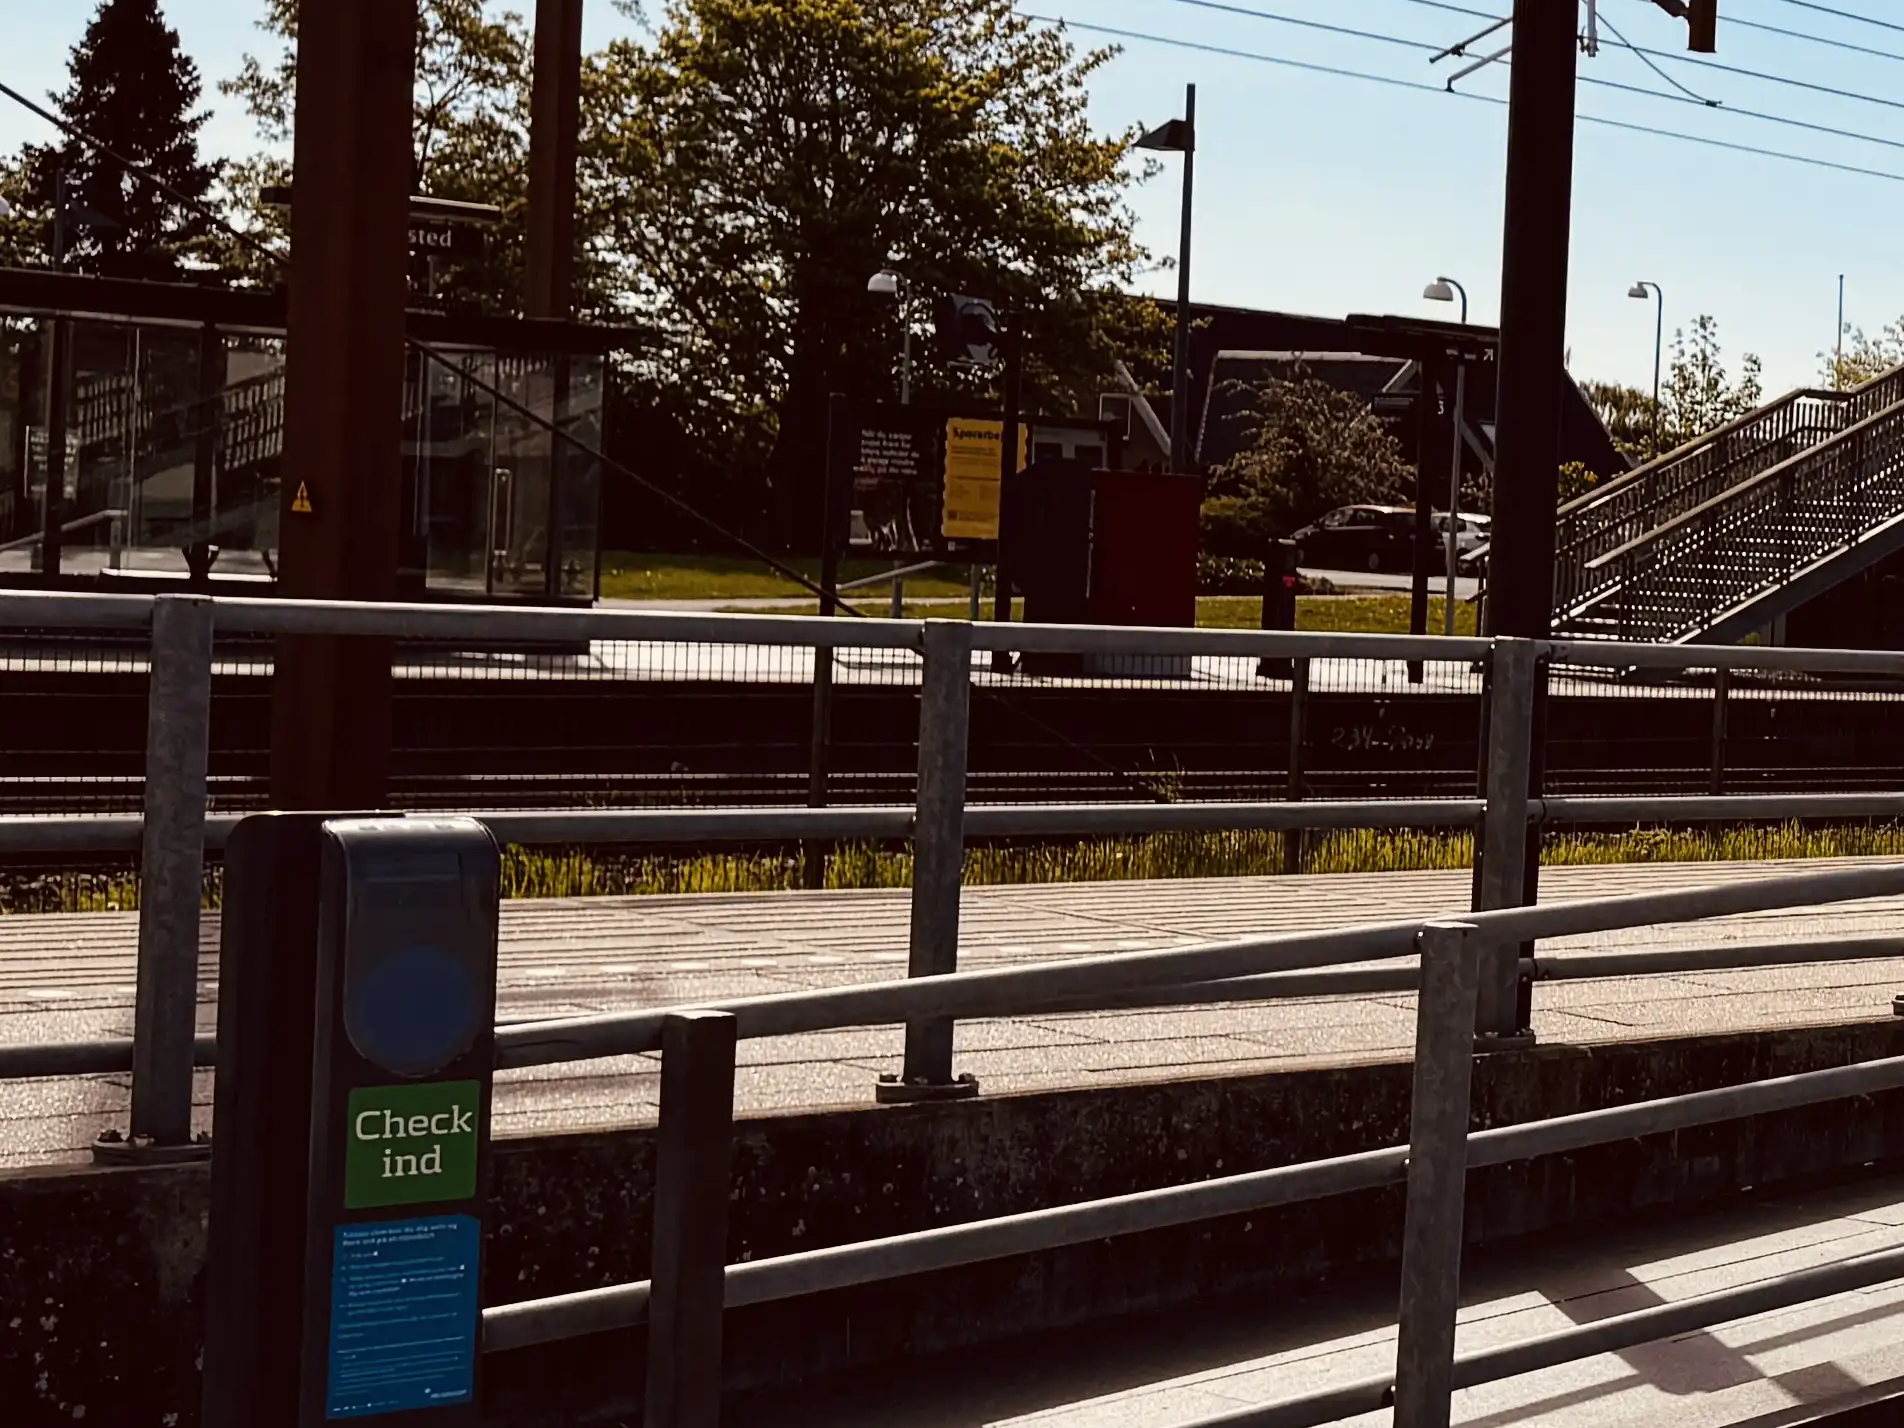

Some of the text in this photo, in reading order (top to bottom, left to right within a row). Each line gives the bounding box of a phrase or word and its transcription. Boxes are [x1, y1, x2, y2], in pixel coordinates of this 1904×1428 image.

[407, 227, 452, 249] sted
[953, 426, 1001, 440] Sporarbe
[355, 1104, 473, 1141] Check
[381, 1144, 442, 1178] ind
